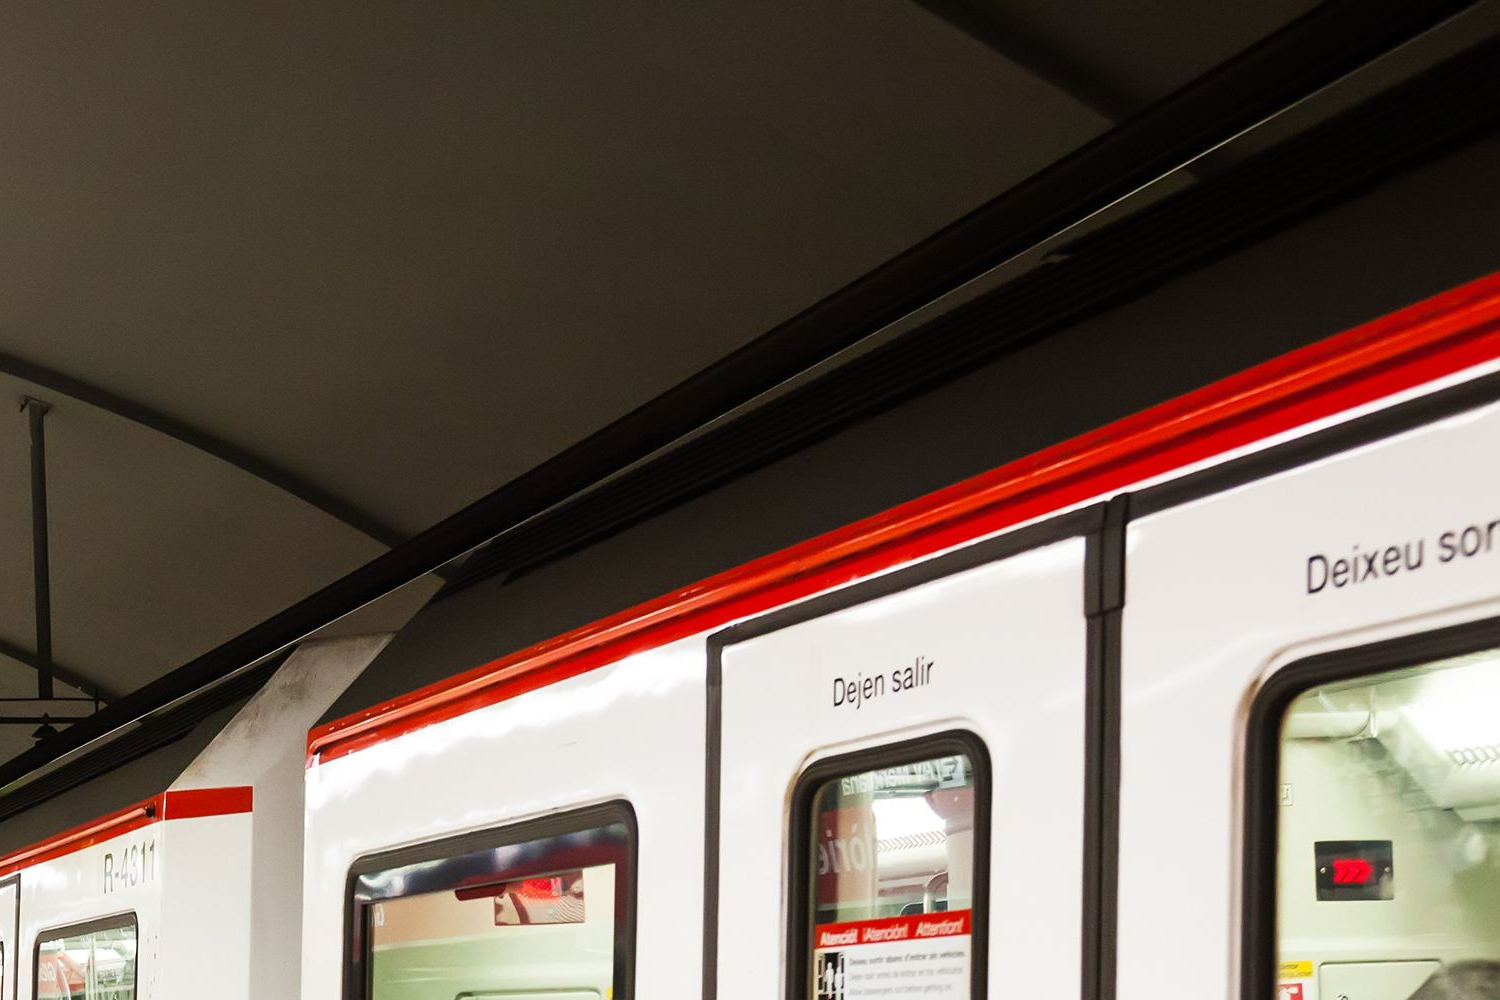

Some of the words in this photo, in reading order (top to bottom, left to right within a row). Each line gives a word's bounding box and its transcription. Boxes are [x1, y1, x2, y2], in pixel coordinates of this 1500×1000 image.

[1306, 538, 1425, 595] Deixeu
[832, 671, 884, 710] Dejen
[891, 656, 934, 692] salir
[103, 839, 156, 894] R-4311
